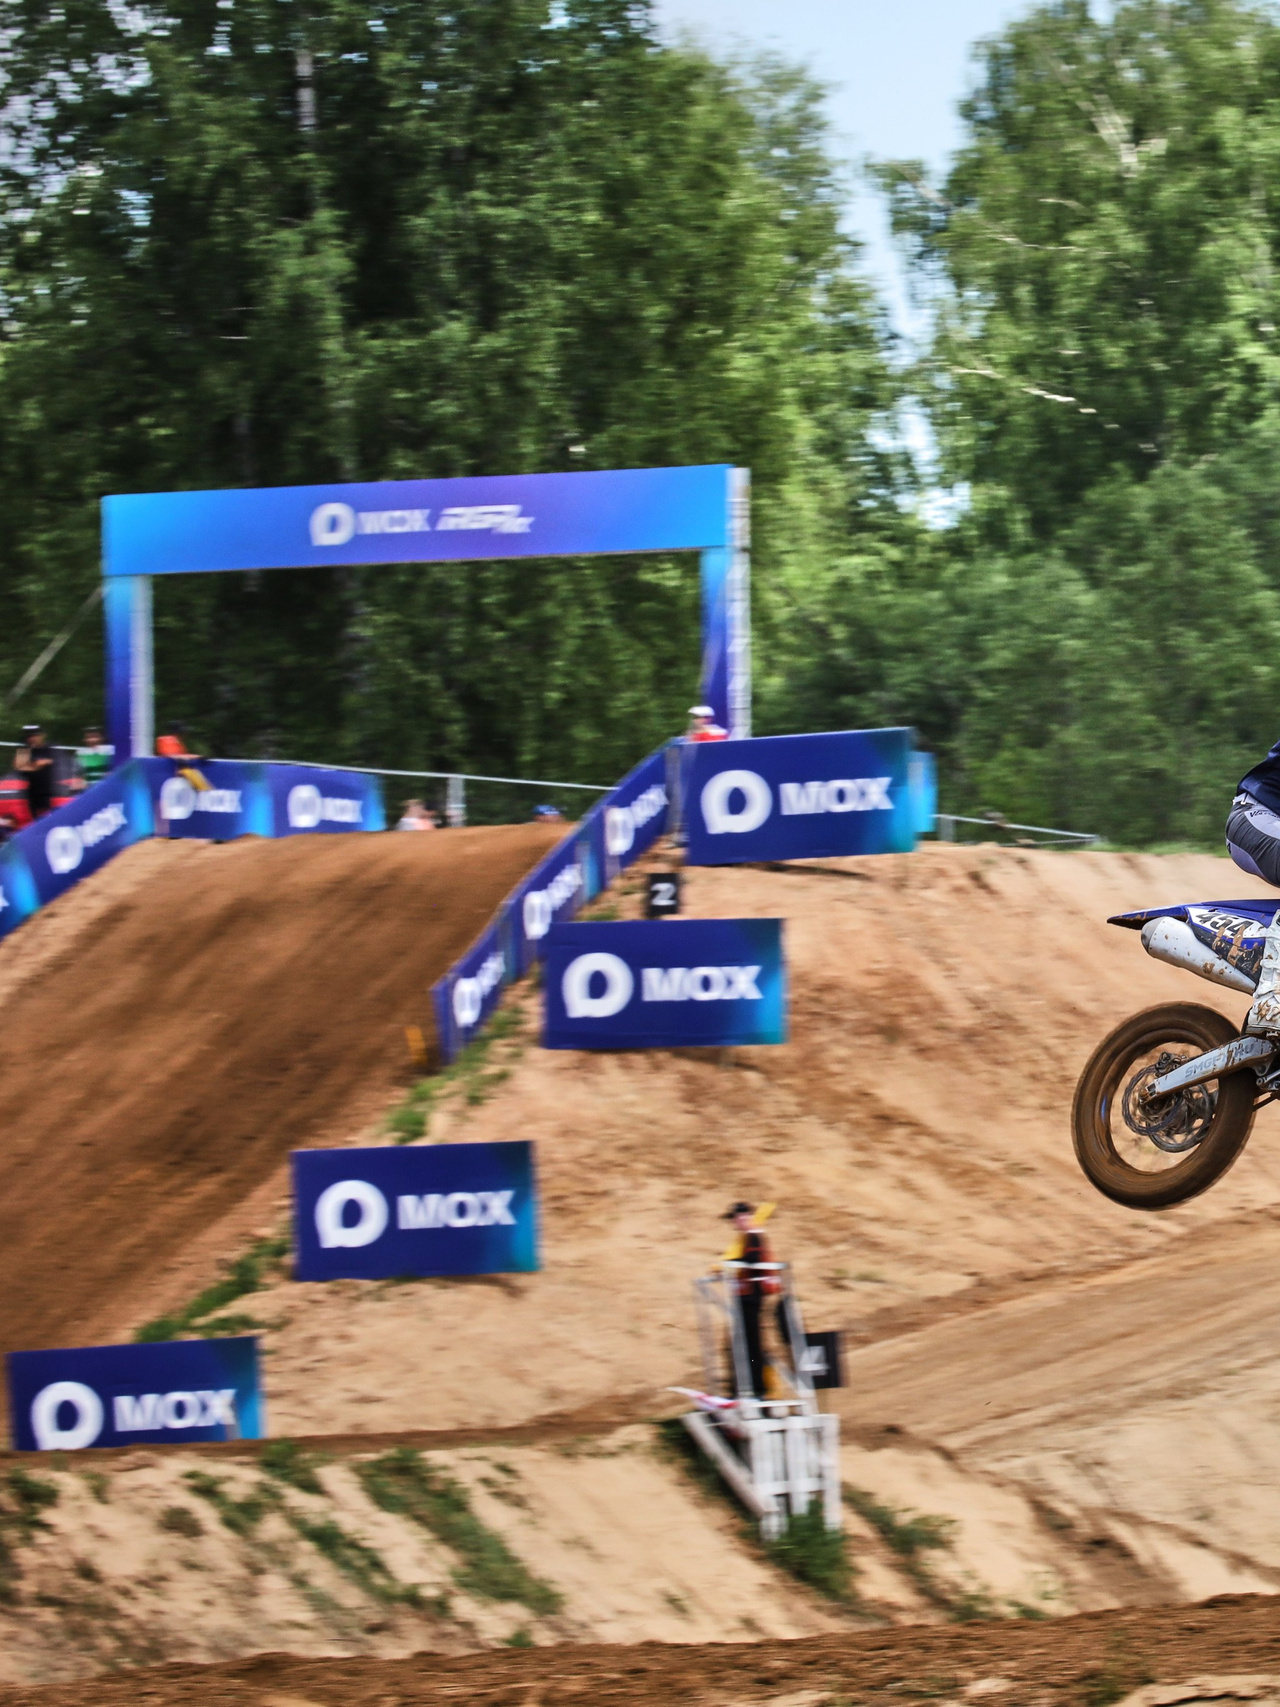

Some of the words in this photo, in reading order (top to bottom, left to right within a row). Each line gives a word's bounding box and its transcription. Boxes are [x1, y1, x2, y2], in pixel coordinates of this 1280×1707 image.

[780, 777, 894, 816] MOX
[650, 882, 677, 907] 2
[1195, 912, 1255, 937] 454
[642, 965, 763, 1003] MOX
[397, 1190, 517, 1231] MOX
[112, 1388, 237, 1433] MOX
